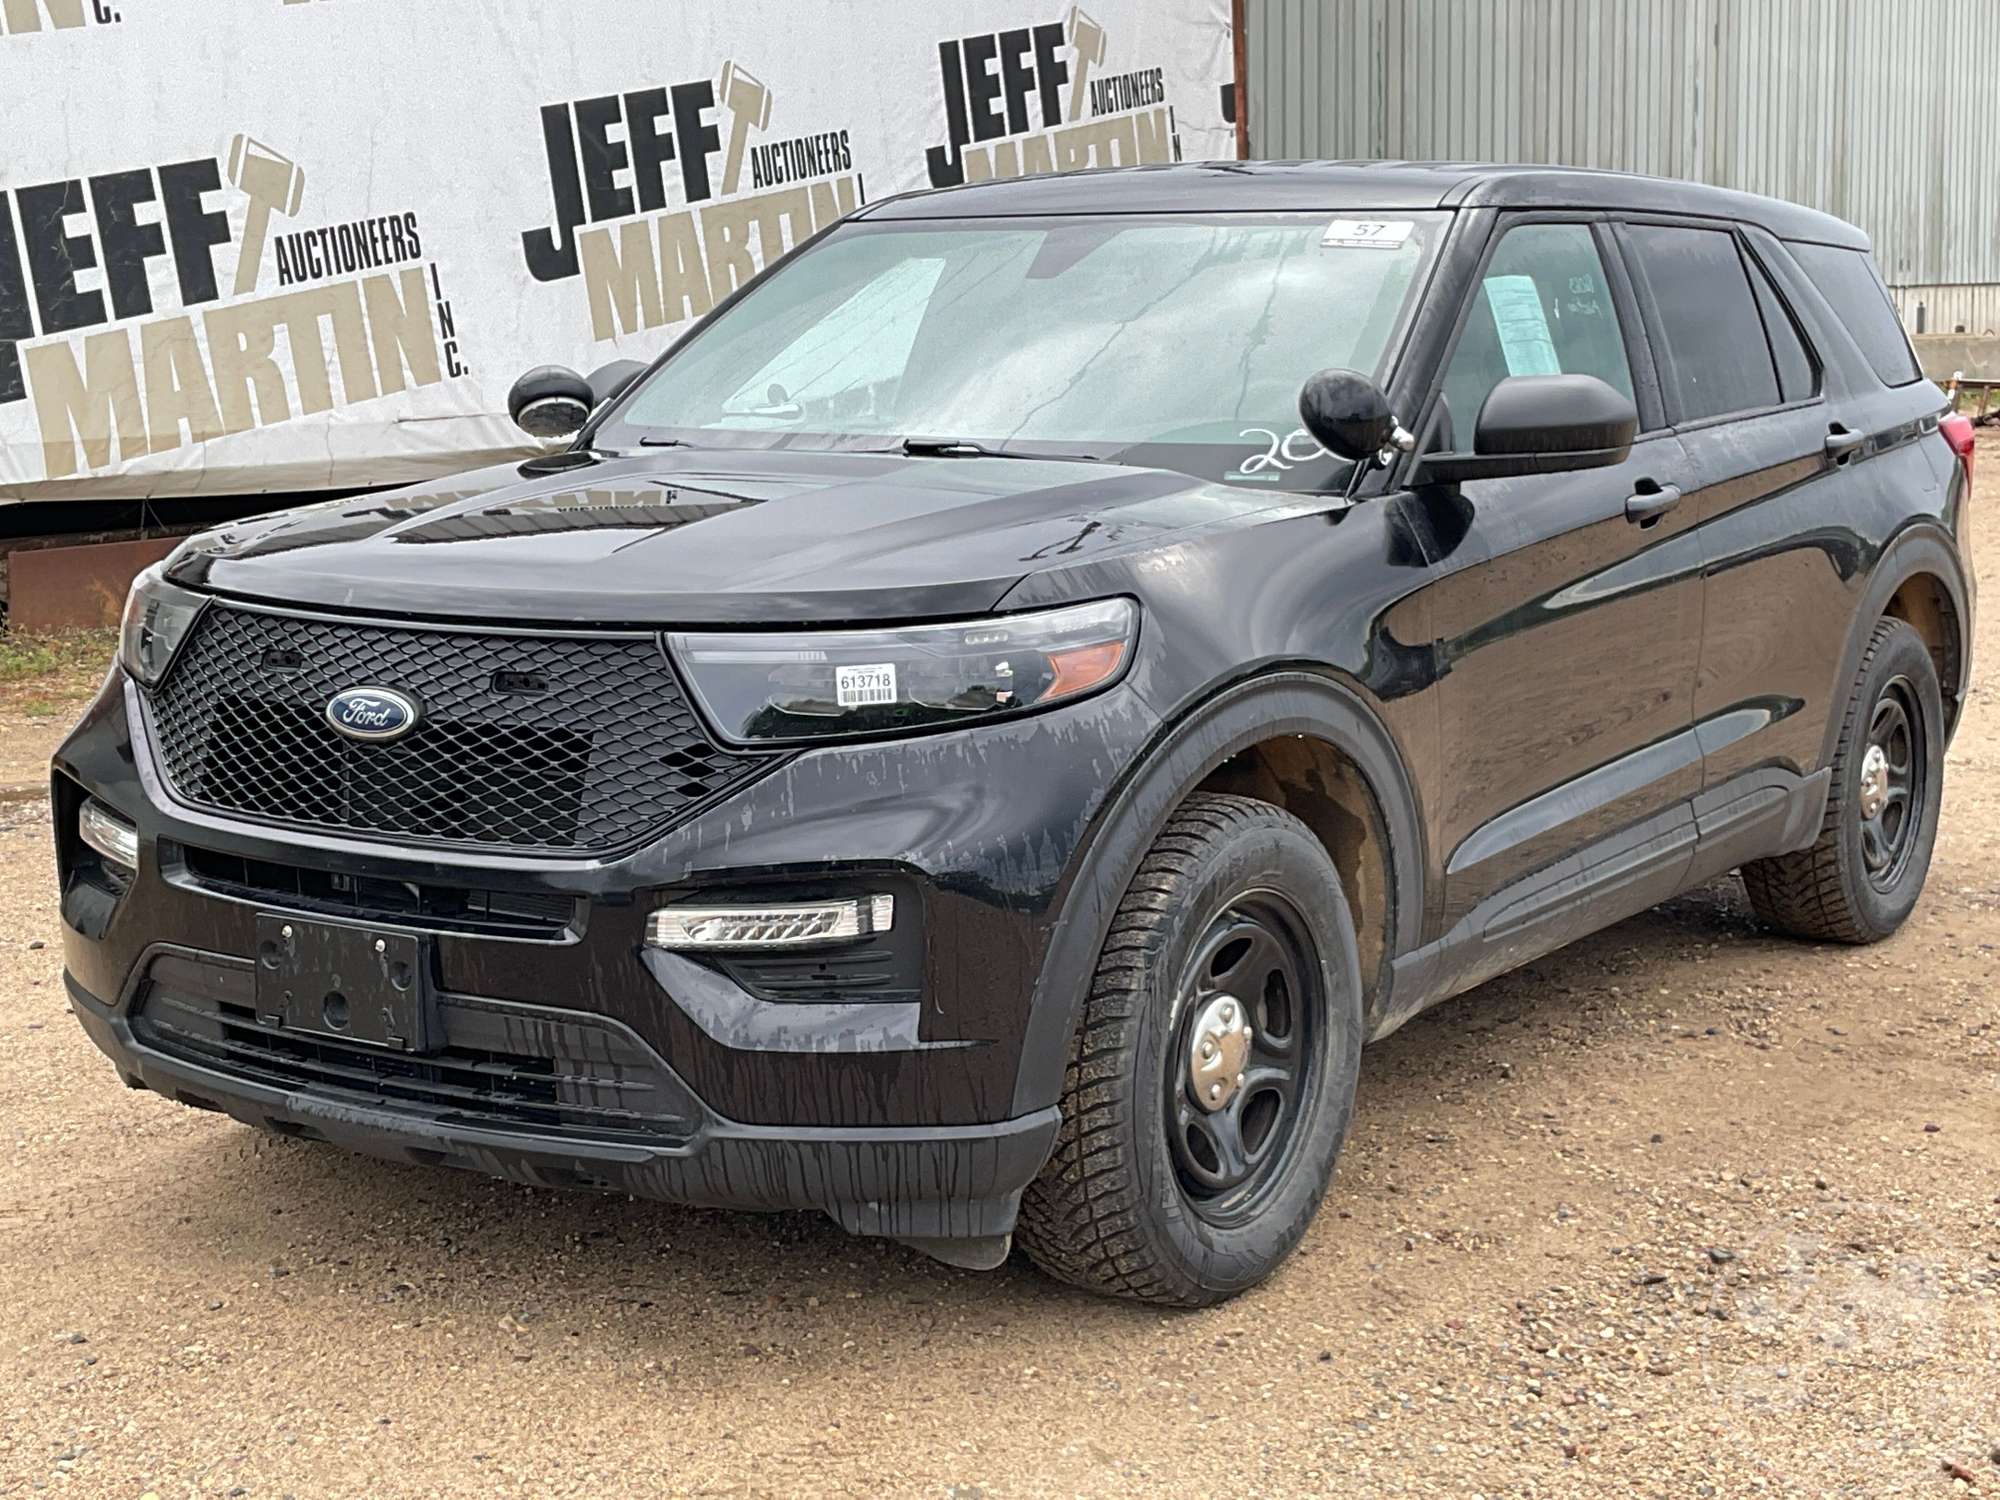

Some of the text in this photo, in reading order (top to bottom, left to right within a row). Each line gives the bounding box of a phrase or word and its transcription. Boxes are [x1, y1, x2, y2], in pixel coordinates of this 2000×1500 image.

[926, 22, 1069, 188] JEFF
[1091, 67, 1165, 117] AUCTIONEERS
[522, 80, 721, 282] JEFF
[751, 130, 852, 189] AUCTIONEERS
[274, 211, 421, 286] AUCTIONEERS
[429, 262, 469, 379] INC.
[25, 267, 442, 480] MARTIN
[343, 698, 391, 726] Ford
[841, 673, 891, 689] 613718
